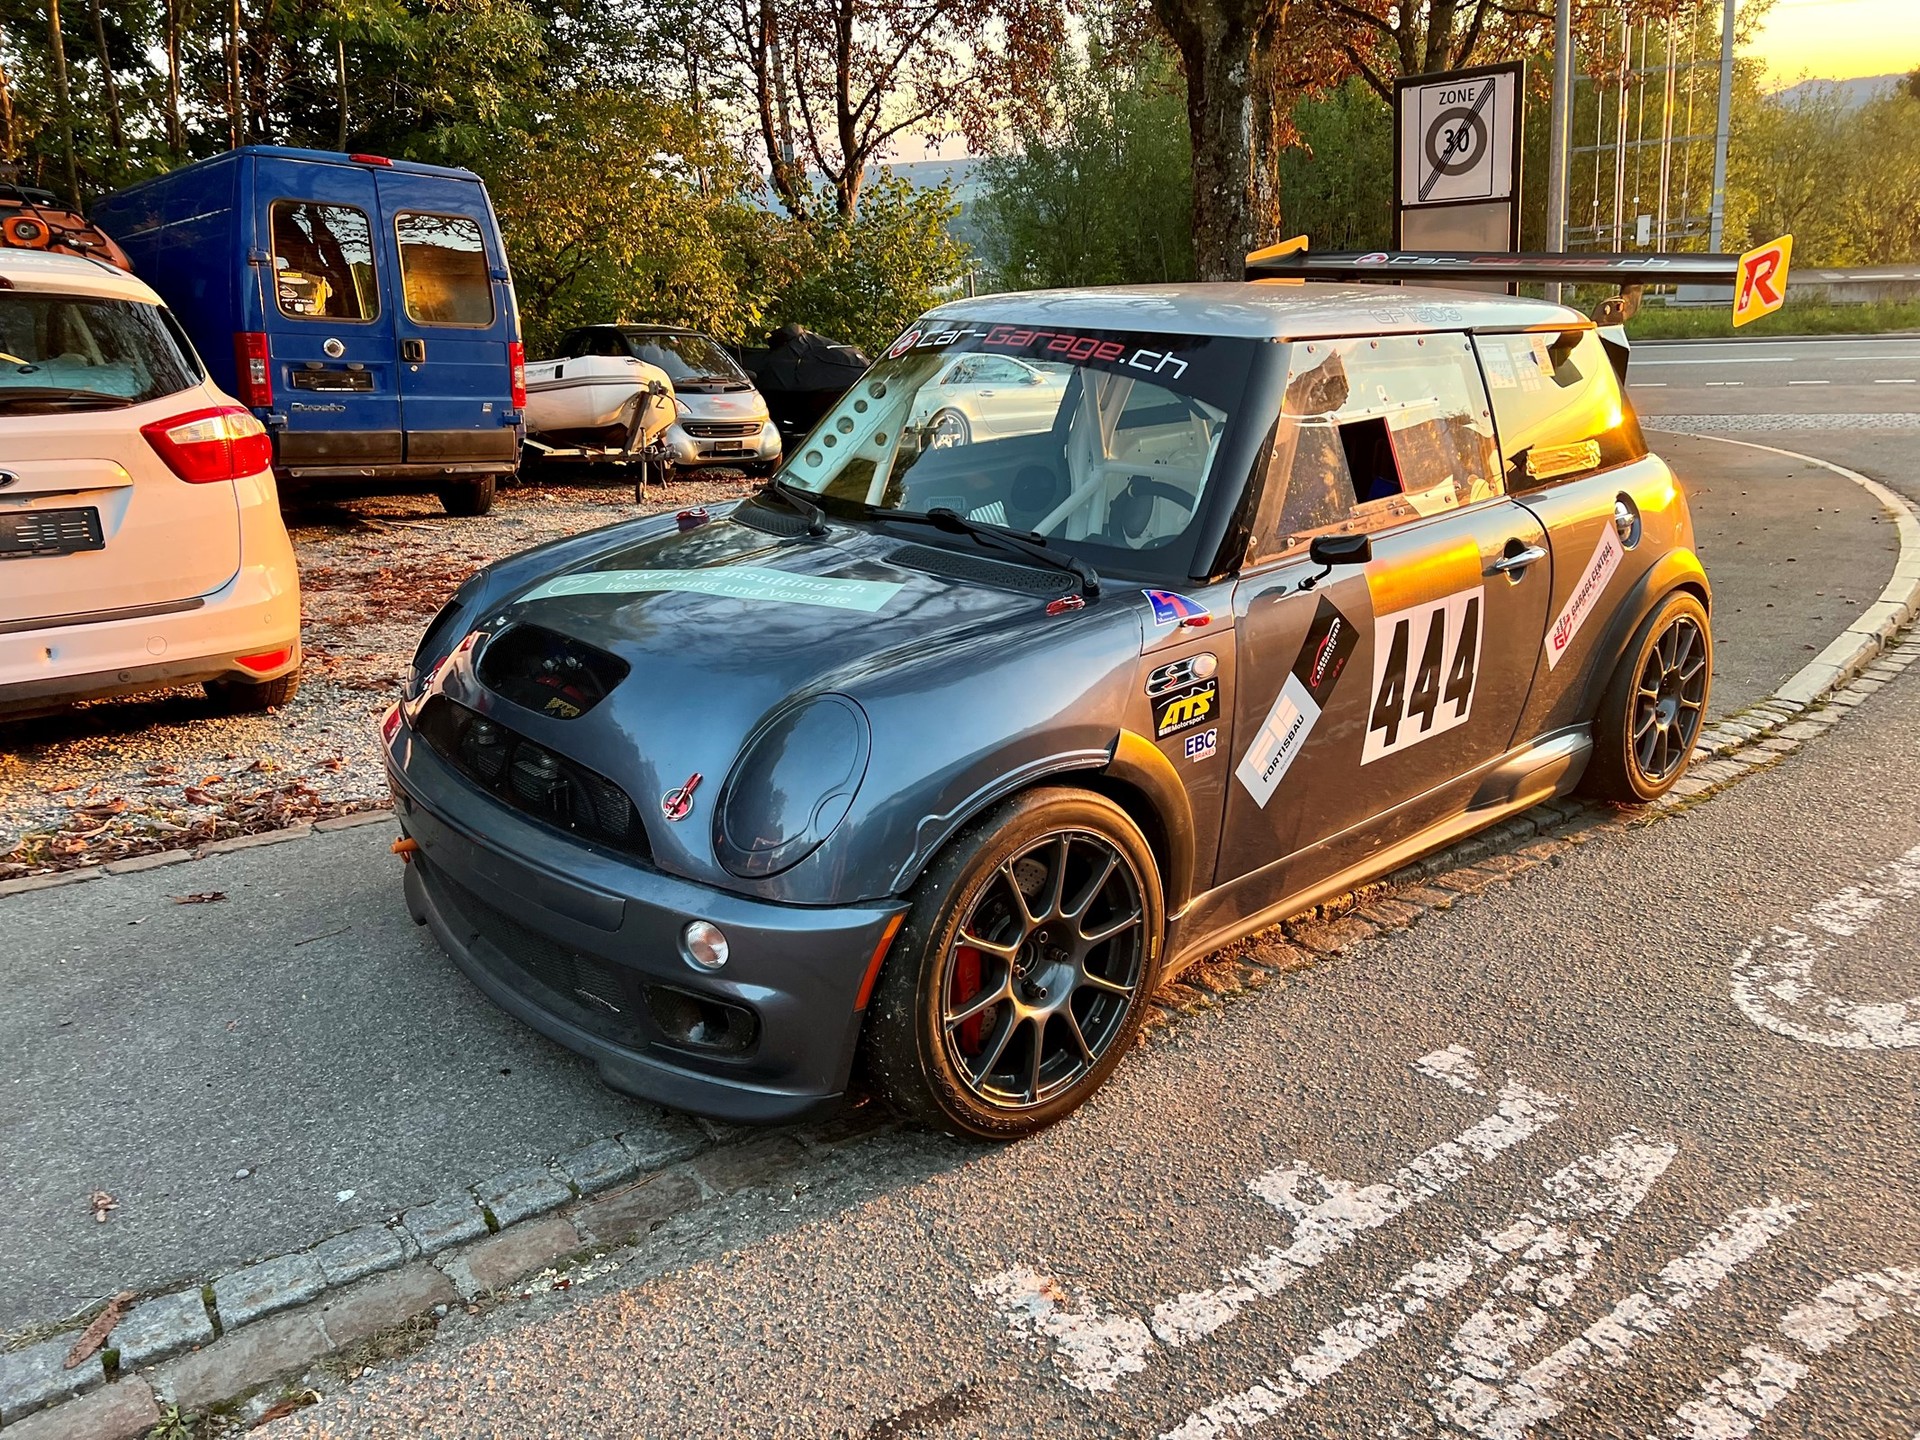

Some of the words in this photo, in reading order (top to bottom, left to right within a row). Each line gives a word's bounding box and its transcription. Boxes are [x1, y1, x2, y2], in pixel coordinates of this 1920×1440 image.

[1439, 88, 1475, 105] ZONE
[1443, 129, 1470, 154] 30
[1737, 250, 1780, 312] R
[915, 326, 1189, 380] car-Garage.ch
[605, 579, 722, 592] Versicherung
[724, 583, 767, 596] und
[768, 588, 851, 605] Vorsorge
[1571, 578, 1593, 616] GARAGE
[1591, 541, 1613, 582] CENTRAL
[1370, 597, 1479, 748] 444
[1159, 689, 1215, 730] ATS
[1171, 714, 1205, 732] Motorsport
[1186, 731, 1216, 757] EBC
[1262, 714, 1305, 783] FORTISBAU
